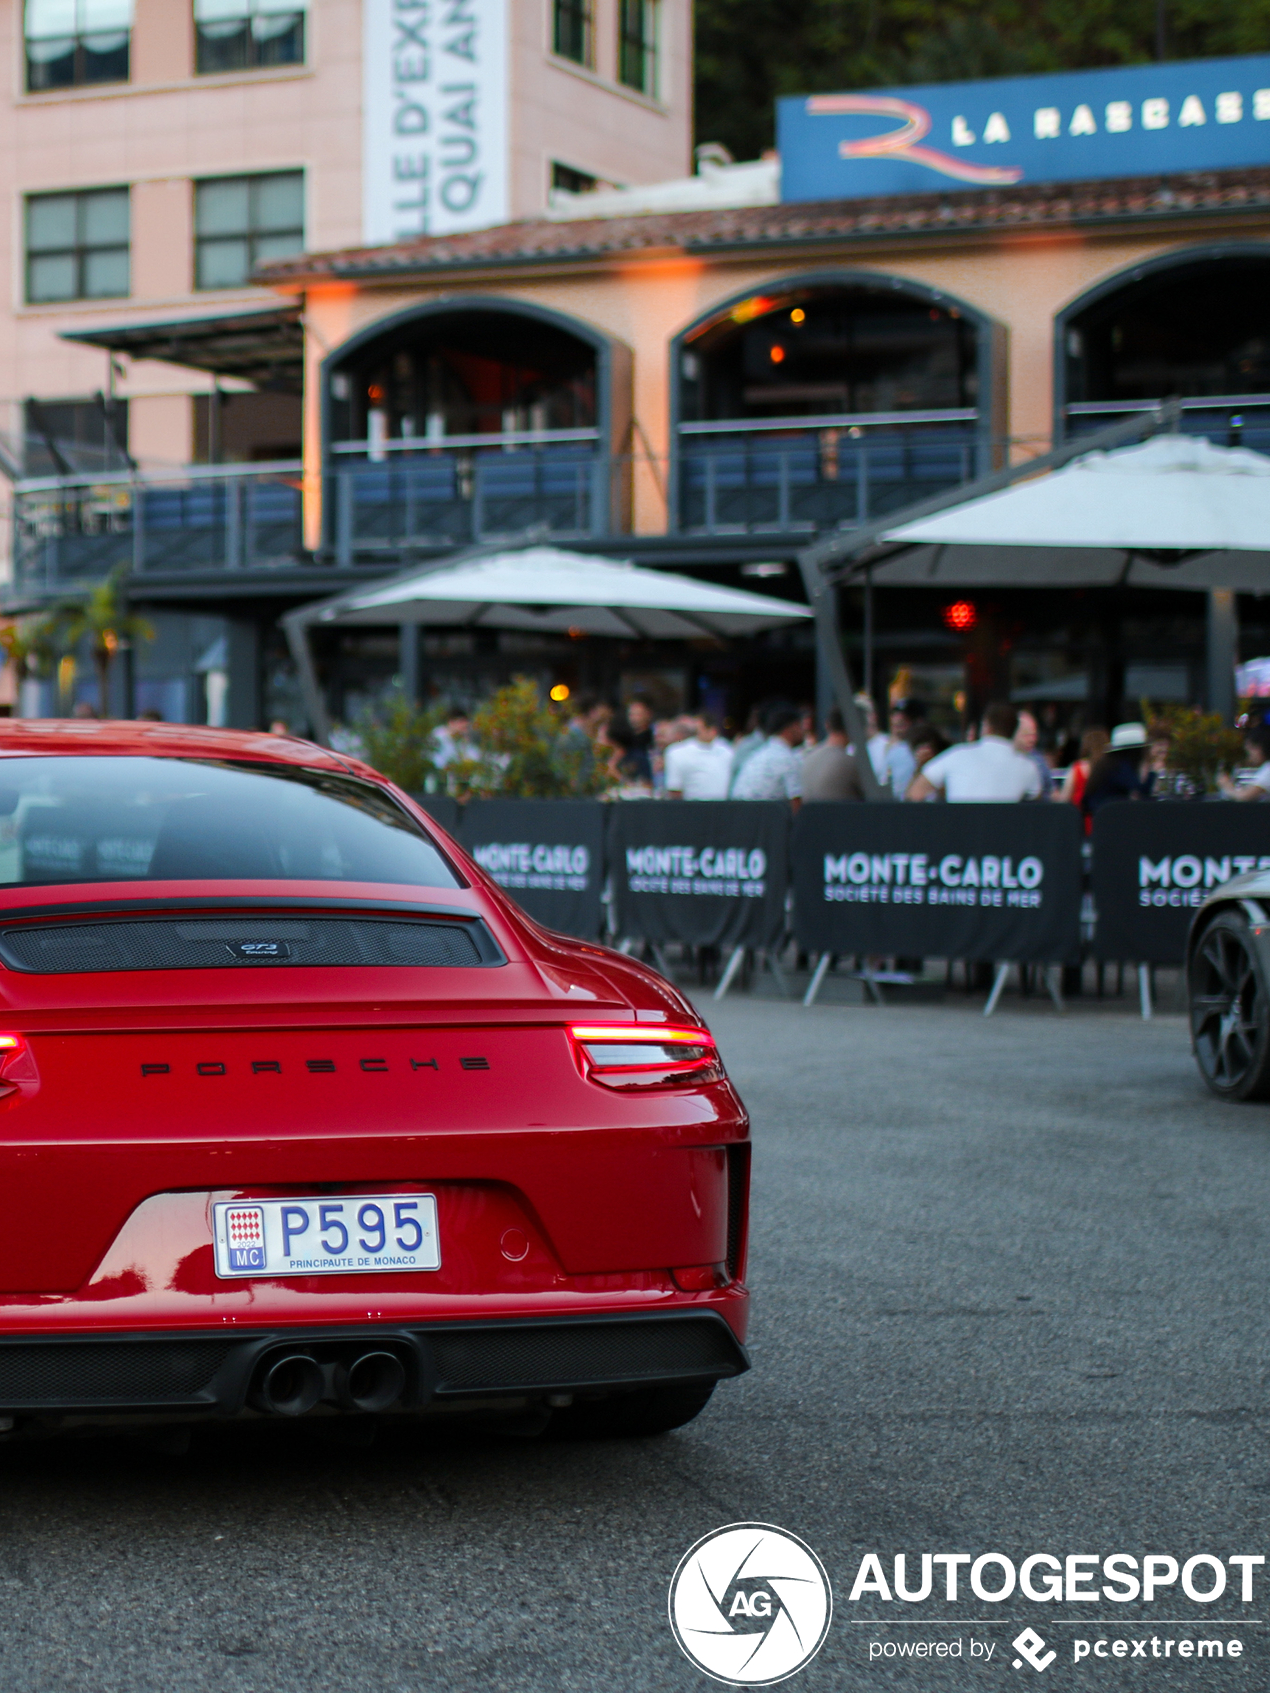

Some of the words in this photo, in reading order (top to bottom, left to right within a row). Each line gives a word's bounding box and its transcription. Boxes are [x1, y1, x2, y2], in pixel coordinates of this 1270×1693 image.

[951, 111, 1012, 147] LA
[439, 83, 486, 213] QUAI
[892, 885, 923, 904] DES
[928, 886, 976, 906] BAINS
[980, 888, 1003, 907] DE
[1007, 889, 1043, 908] MER
[241, 943, 277, 951] GT3
[141, 1057, 490, 1077] PORSCHE
[280, 1202, 423, 1257] P595
[236, 1249, 260, 1266] MC
[290, 1258, 354, 1268] PRINCIPAUTE
[358, 1257, 370, 1266] DE
[374, 1255, 416, 1265] MONACO
